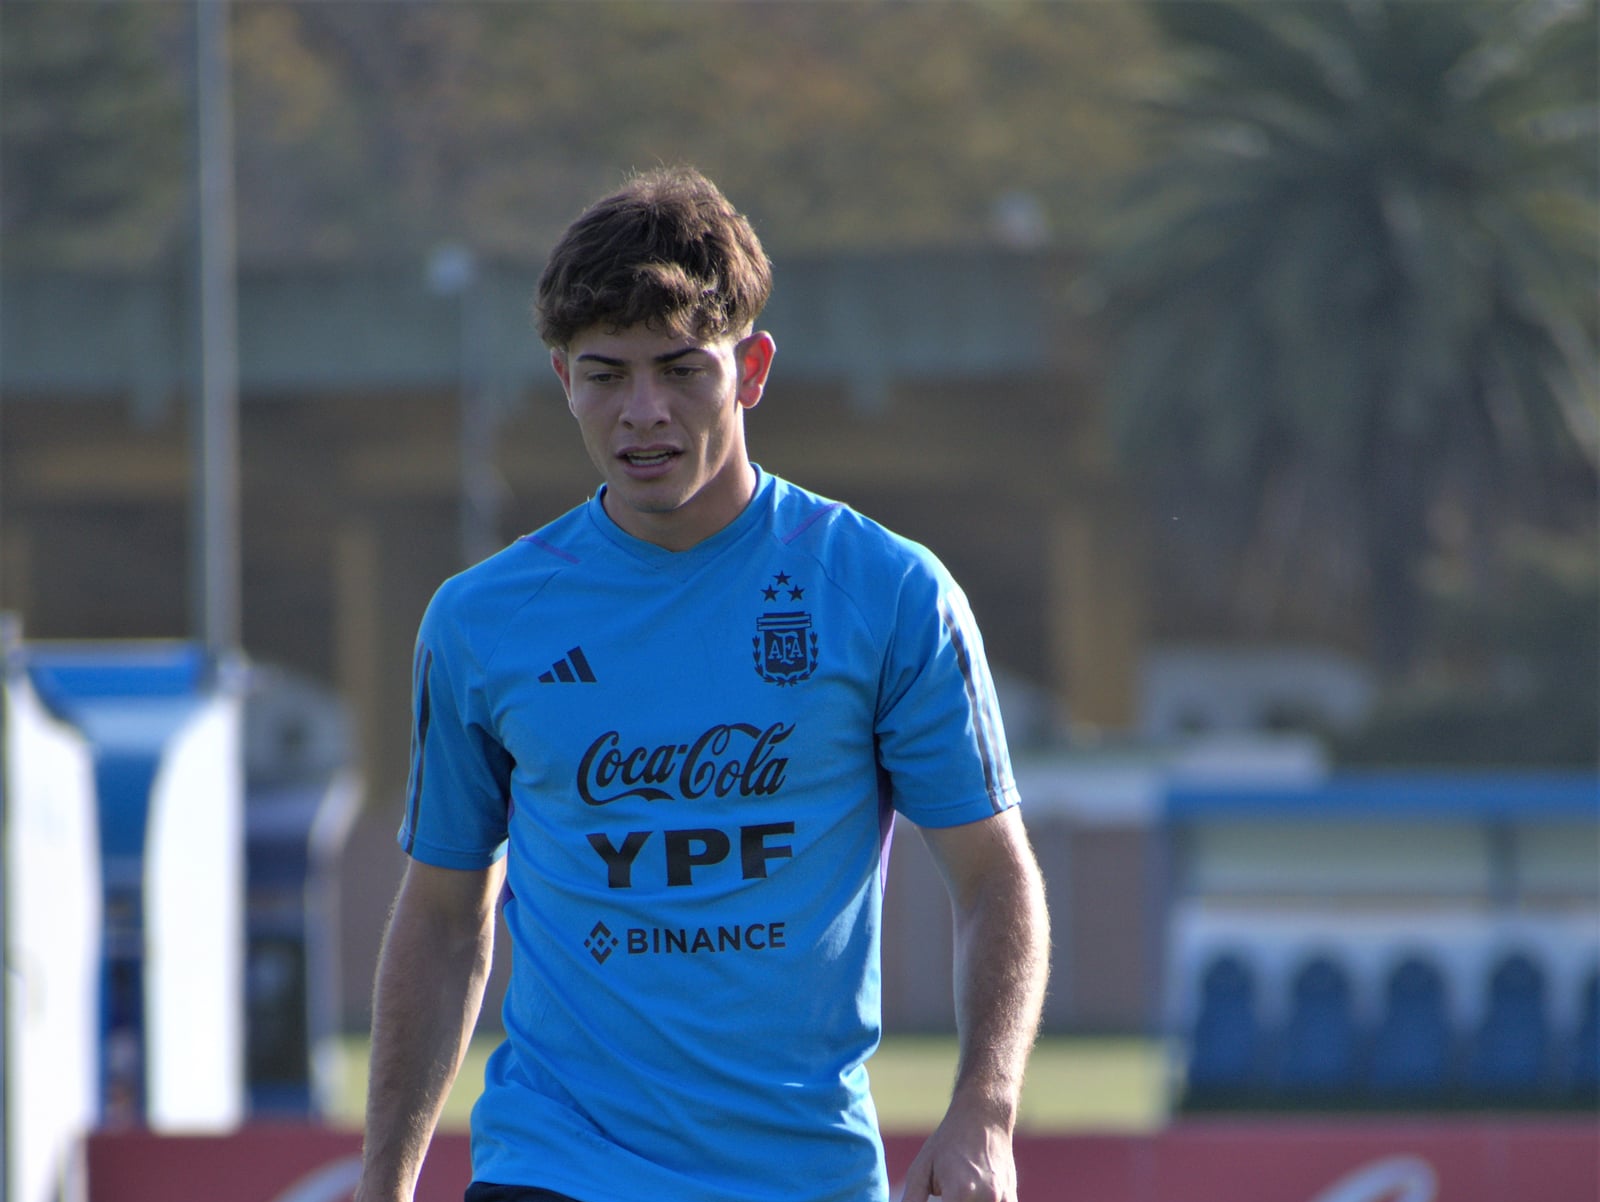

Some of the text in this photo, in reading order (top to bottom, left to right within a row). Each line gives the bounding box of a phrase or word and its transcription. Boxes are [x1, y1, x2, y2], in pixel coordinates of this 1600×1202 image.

[768, 631, 804, 665] AFA
[577, 722, 796, 806] Coca-Cola
[586, 821, 796, 888] YPF
[626, 922, 786, 954] BINANCE
